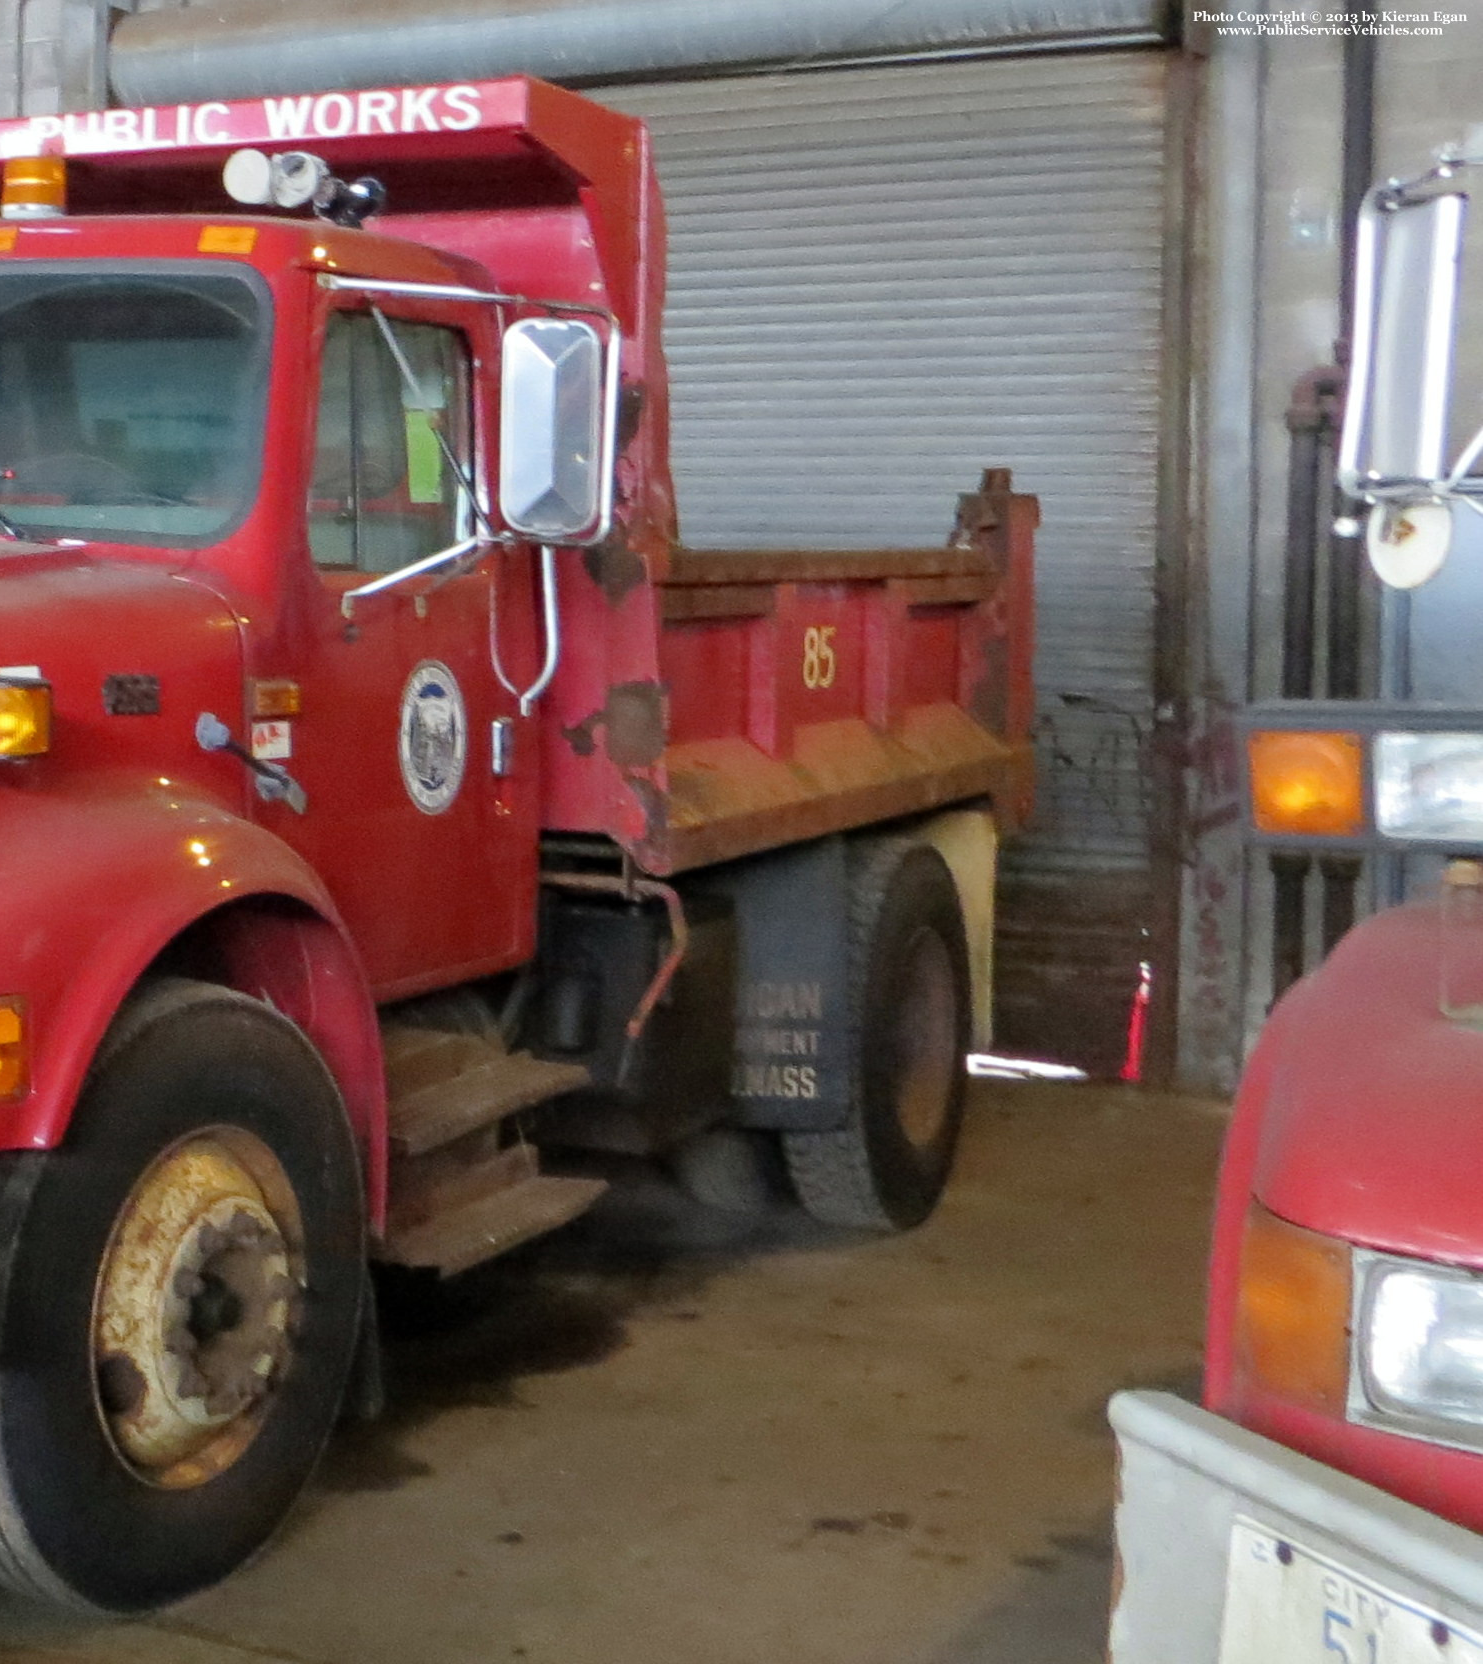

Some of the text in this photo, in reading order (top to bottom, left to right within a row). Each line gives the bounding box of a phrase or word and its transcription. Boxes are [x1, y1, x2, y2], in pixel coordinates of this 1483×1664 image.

[29, 103, 230, 156] PUBLIC
[263, 85, 482, 139] WORKS
[803, 626, 836, 689] 85
[1321, 1576, 1390, 1627] CITY
